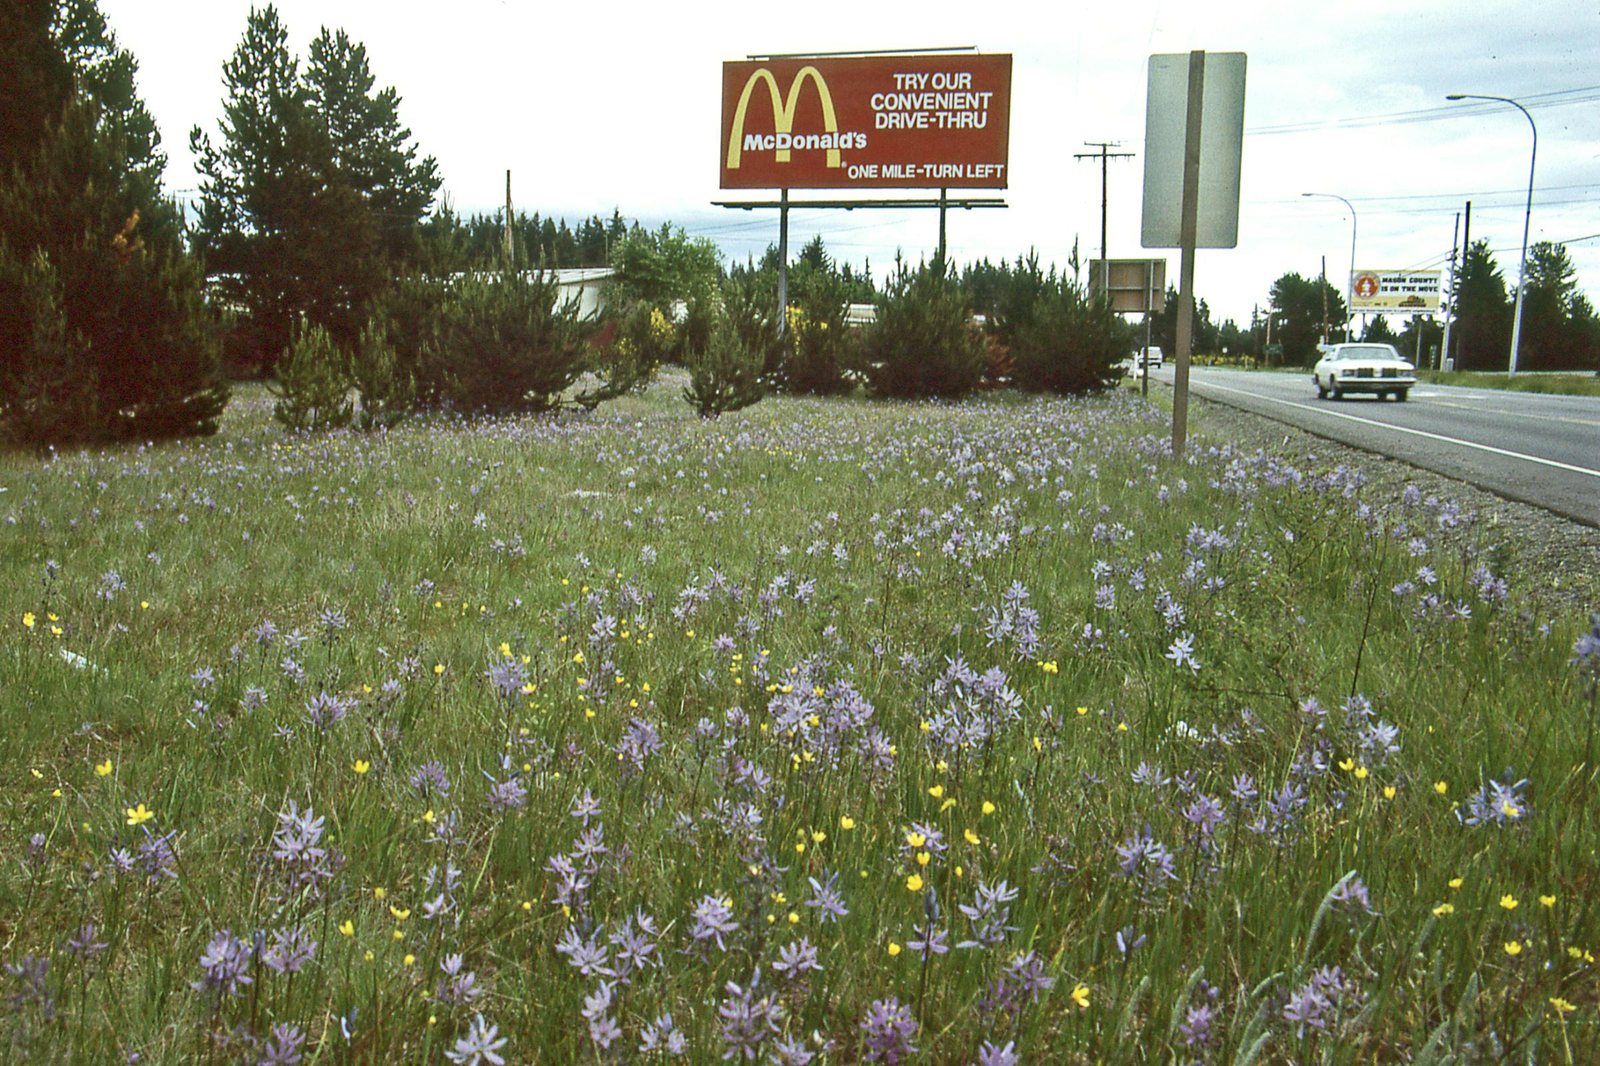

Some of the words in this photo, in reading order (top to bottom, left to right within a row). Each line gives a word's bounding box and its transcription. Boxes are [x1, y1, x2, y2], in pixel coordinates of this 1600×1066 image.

[893, 73, 930, 90] TRY
[931, 73, 972, 89] OUR
[870, 92, 993, 110] CONVENIENT
[875, 111, 988, 128] DRIVE-THRU
[743, 132, 868, 151] McDonald's
[847, 164, 878, 179] ONE
[966, 164, 1004, 178] LEFT
